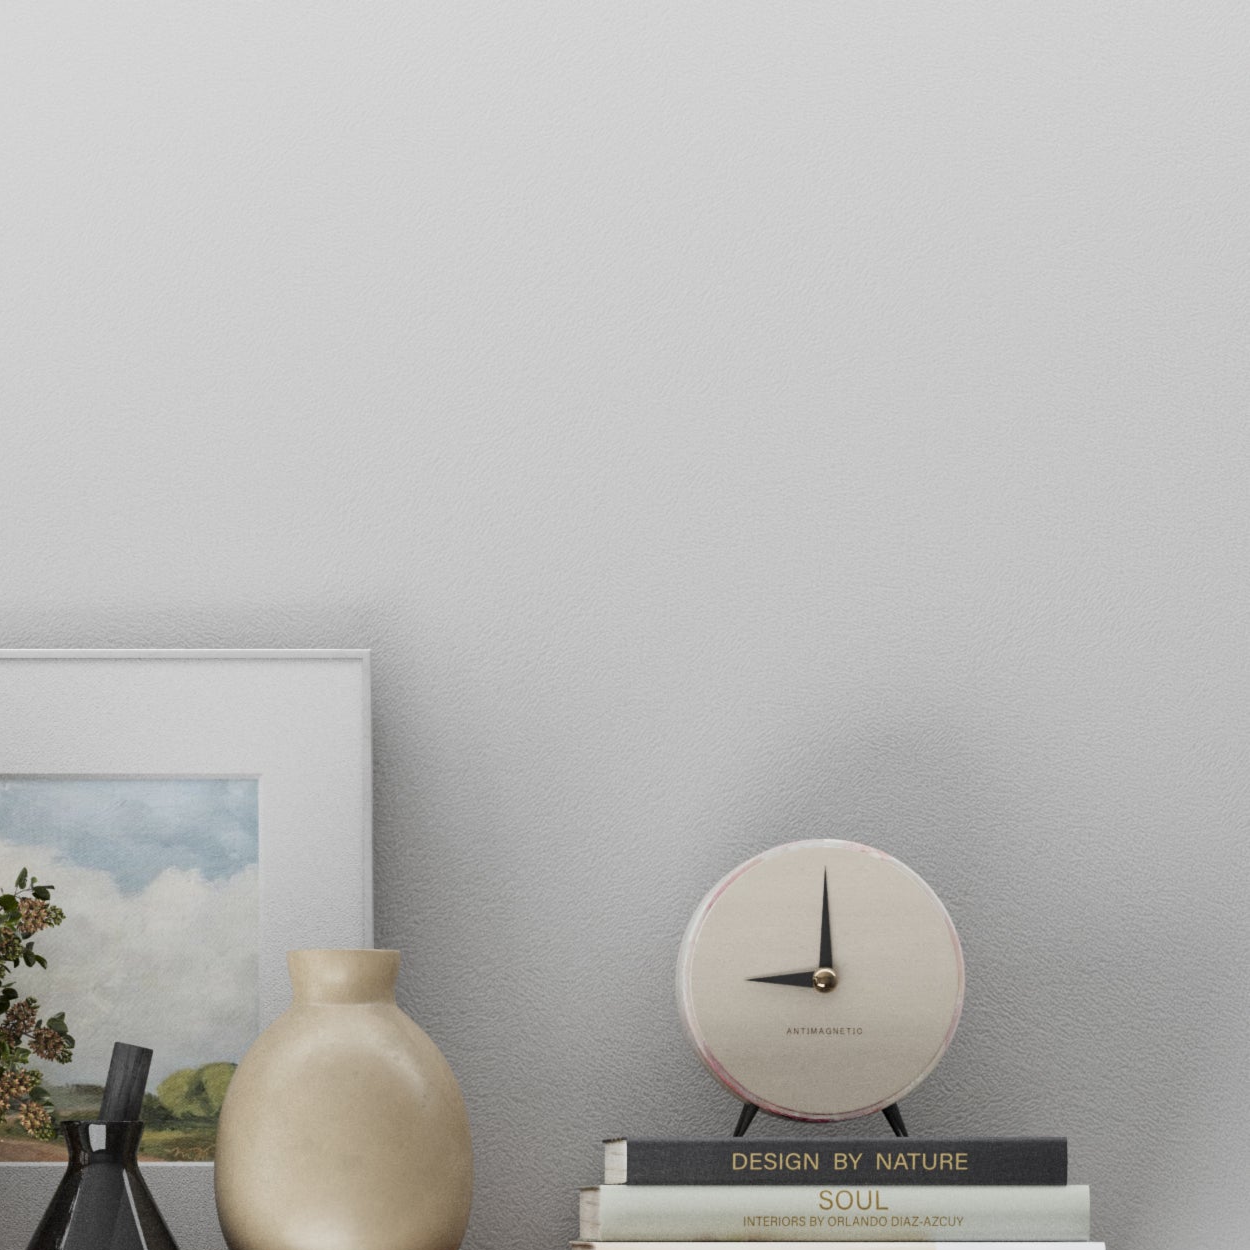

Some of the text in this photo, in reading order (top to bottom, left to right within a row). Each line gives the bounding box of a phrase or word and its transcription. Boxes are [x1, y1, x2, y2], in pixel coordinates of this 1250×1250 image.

[785, 1026, 863, 1036] ANTIMAGNETIC
[732, 1152, 969, 1172] DESIGN BY NATURE
[818, 1190, 889, 1211] SOUL
[743, 1216, 964, 1228] INTERIORS BY ORLANDO DIAZ-AZCUY
